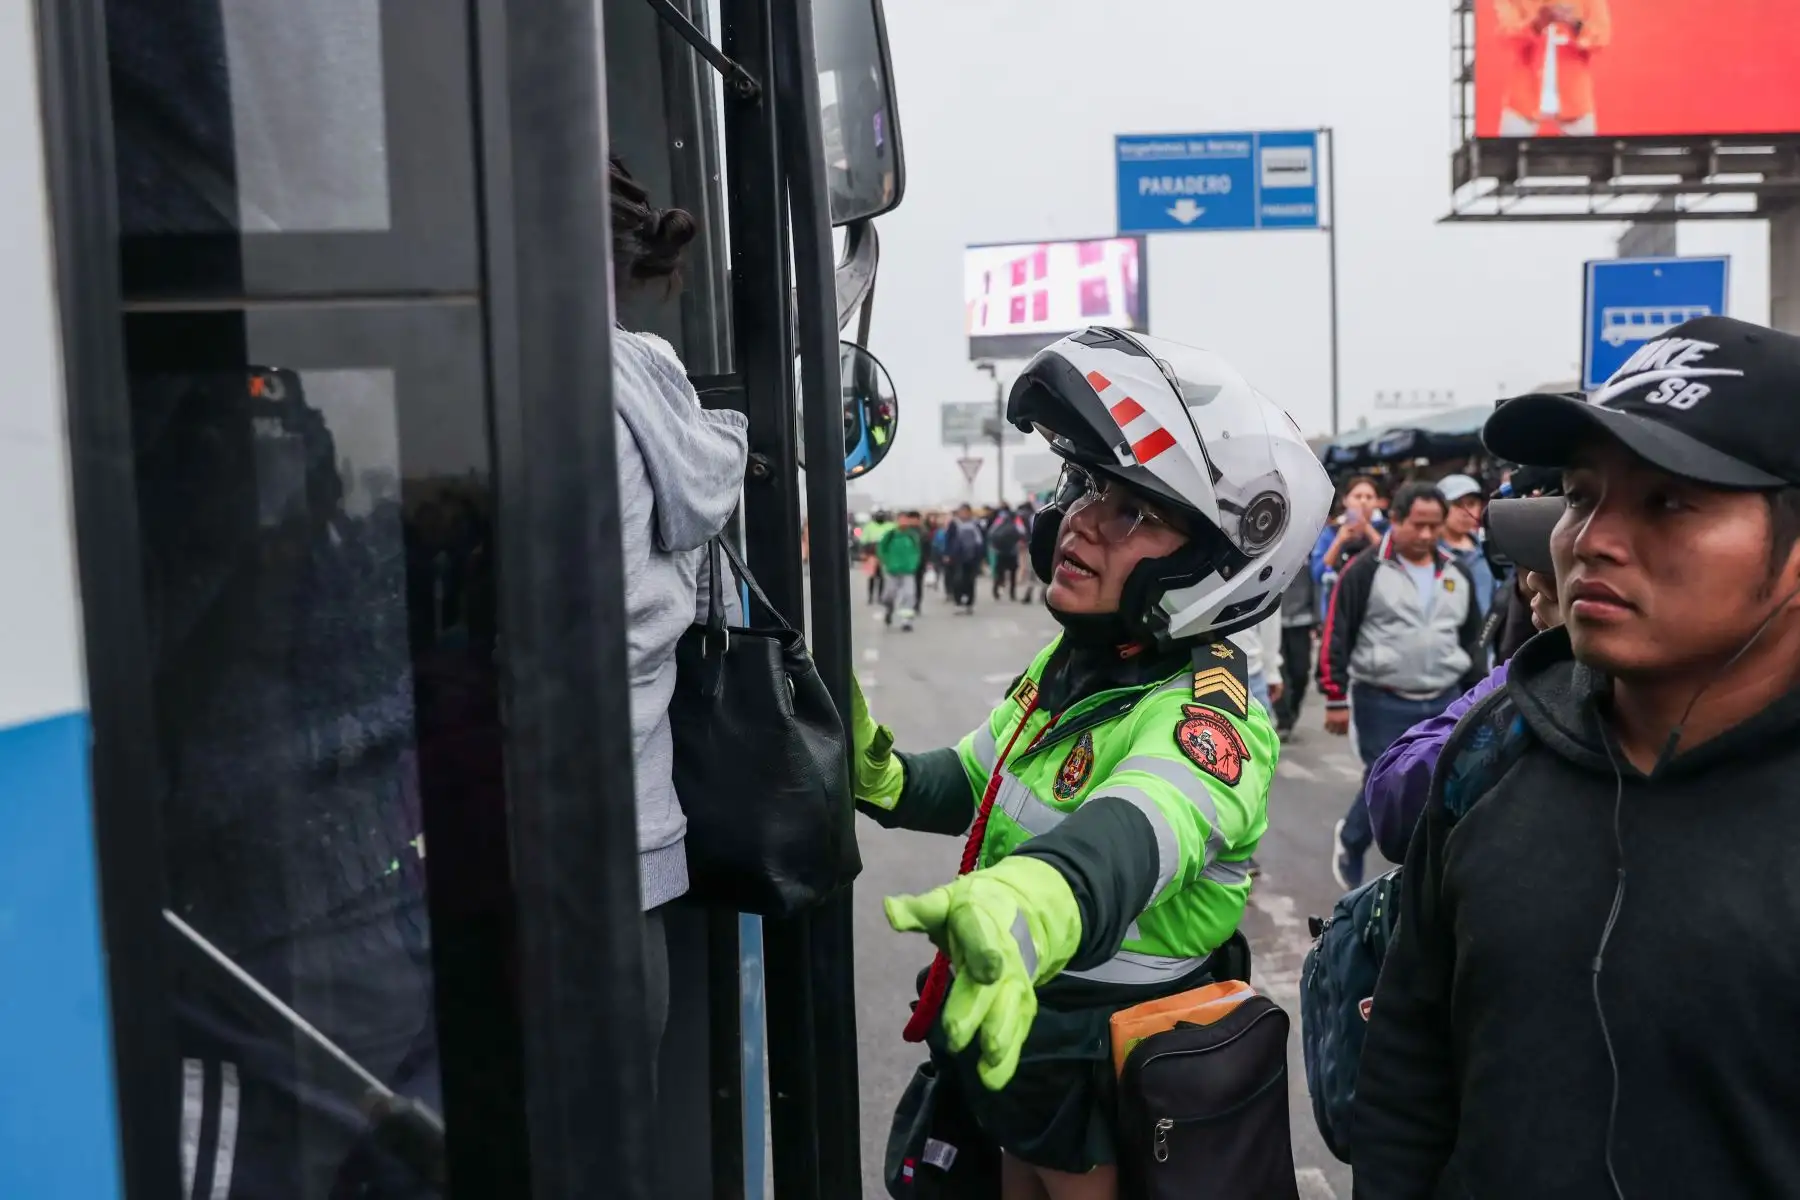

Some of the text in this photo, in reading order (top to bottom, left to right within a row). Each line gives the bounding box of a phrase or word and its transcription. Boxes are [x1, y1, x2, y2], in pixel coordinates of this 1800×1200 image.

[1139, 174, 1231, 196] PARADERO
[1612, 338, 1720, 373] NIKE
[1645, 377, 1711, 410] SB
